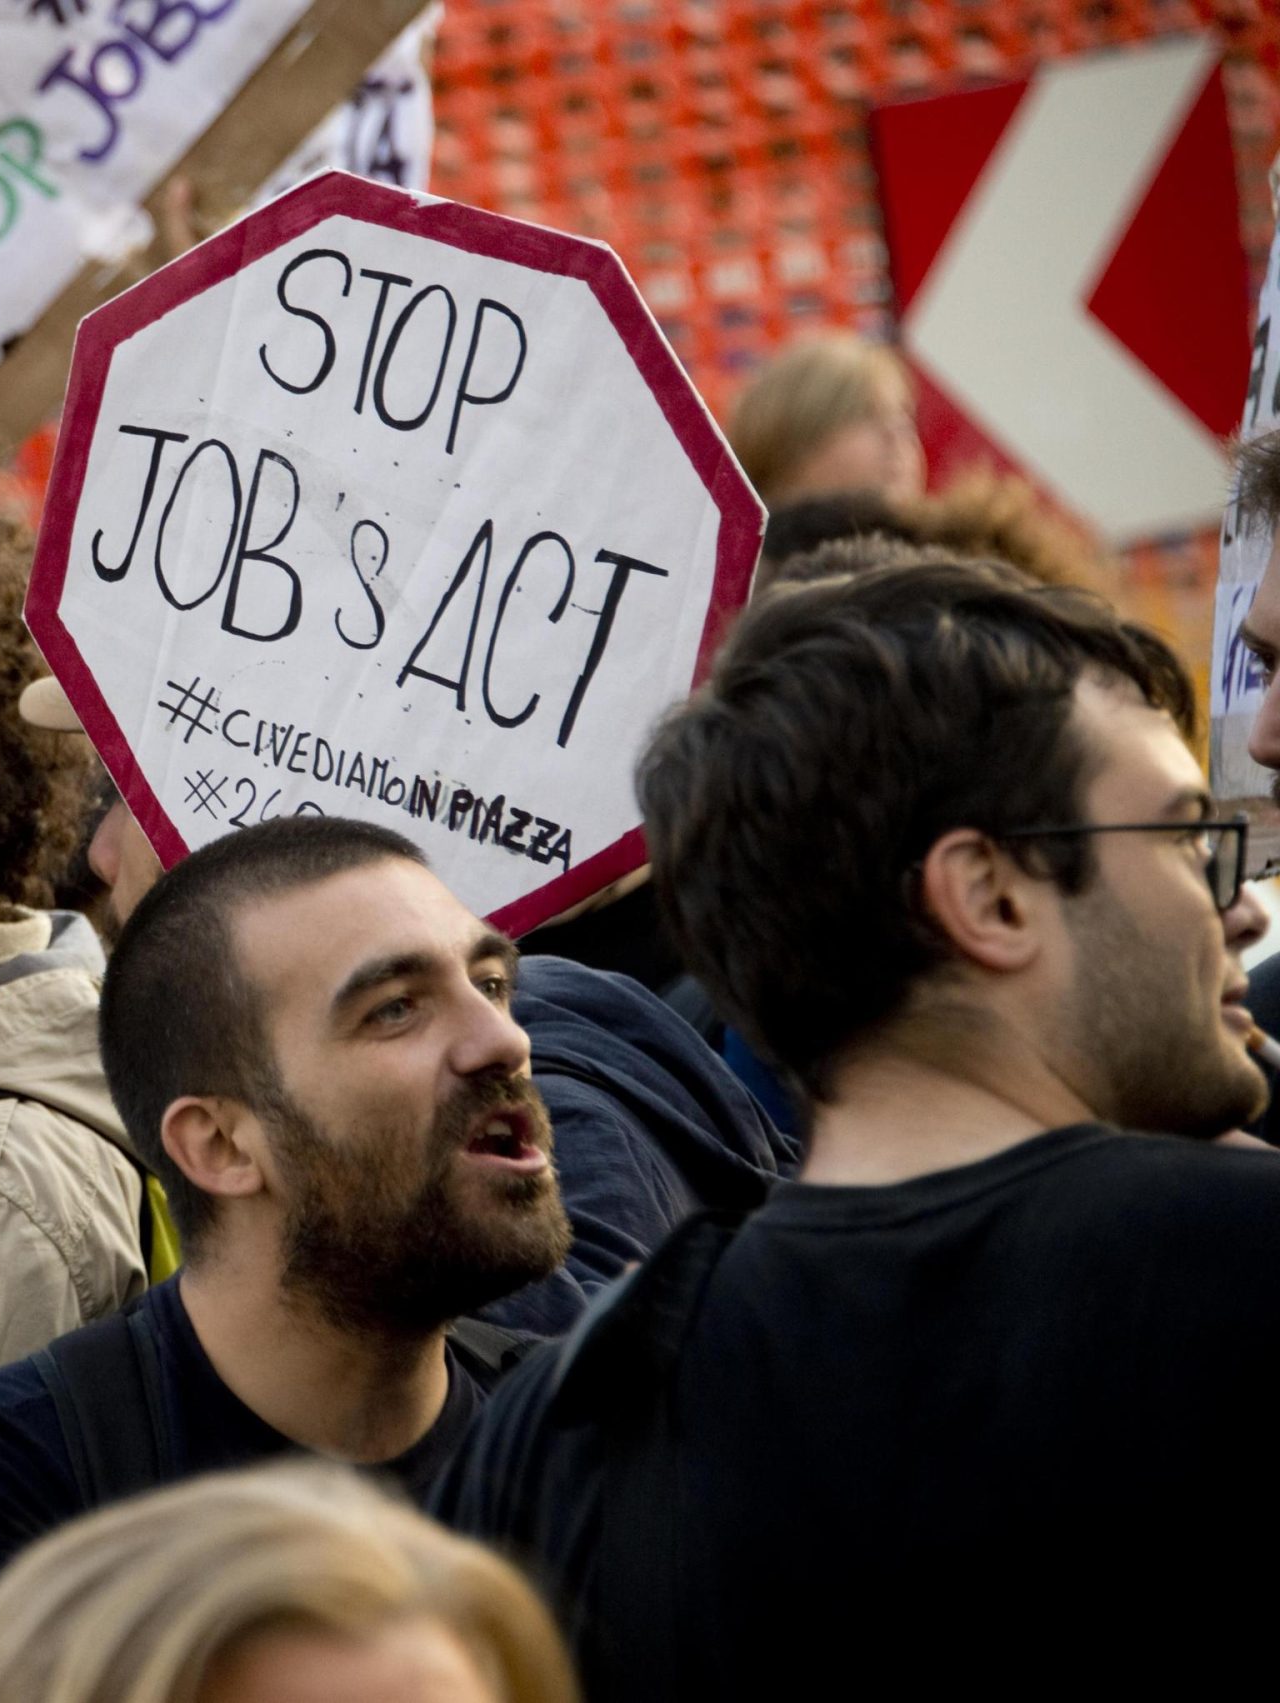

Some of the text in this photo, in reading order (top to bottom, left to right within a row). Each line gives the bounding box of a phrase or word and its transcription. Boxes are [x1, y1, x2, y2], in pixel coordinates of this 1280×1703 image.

[260, 248, 527, 454] STOP
[91, 424, 670, 749] JOB'S ACT
